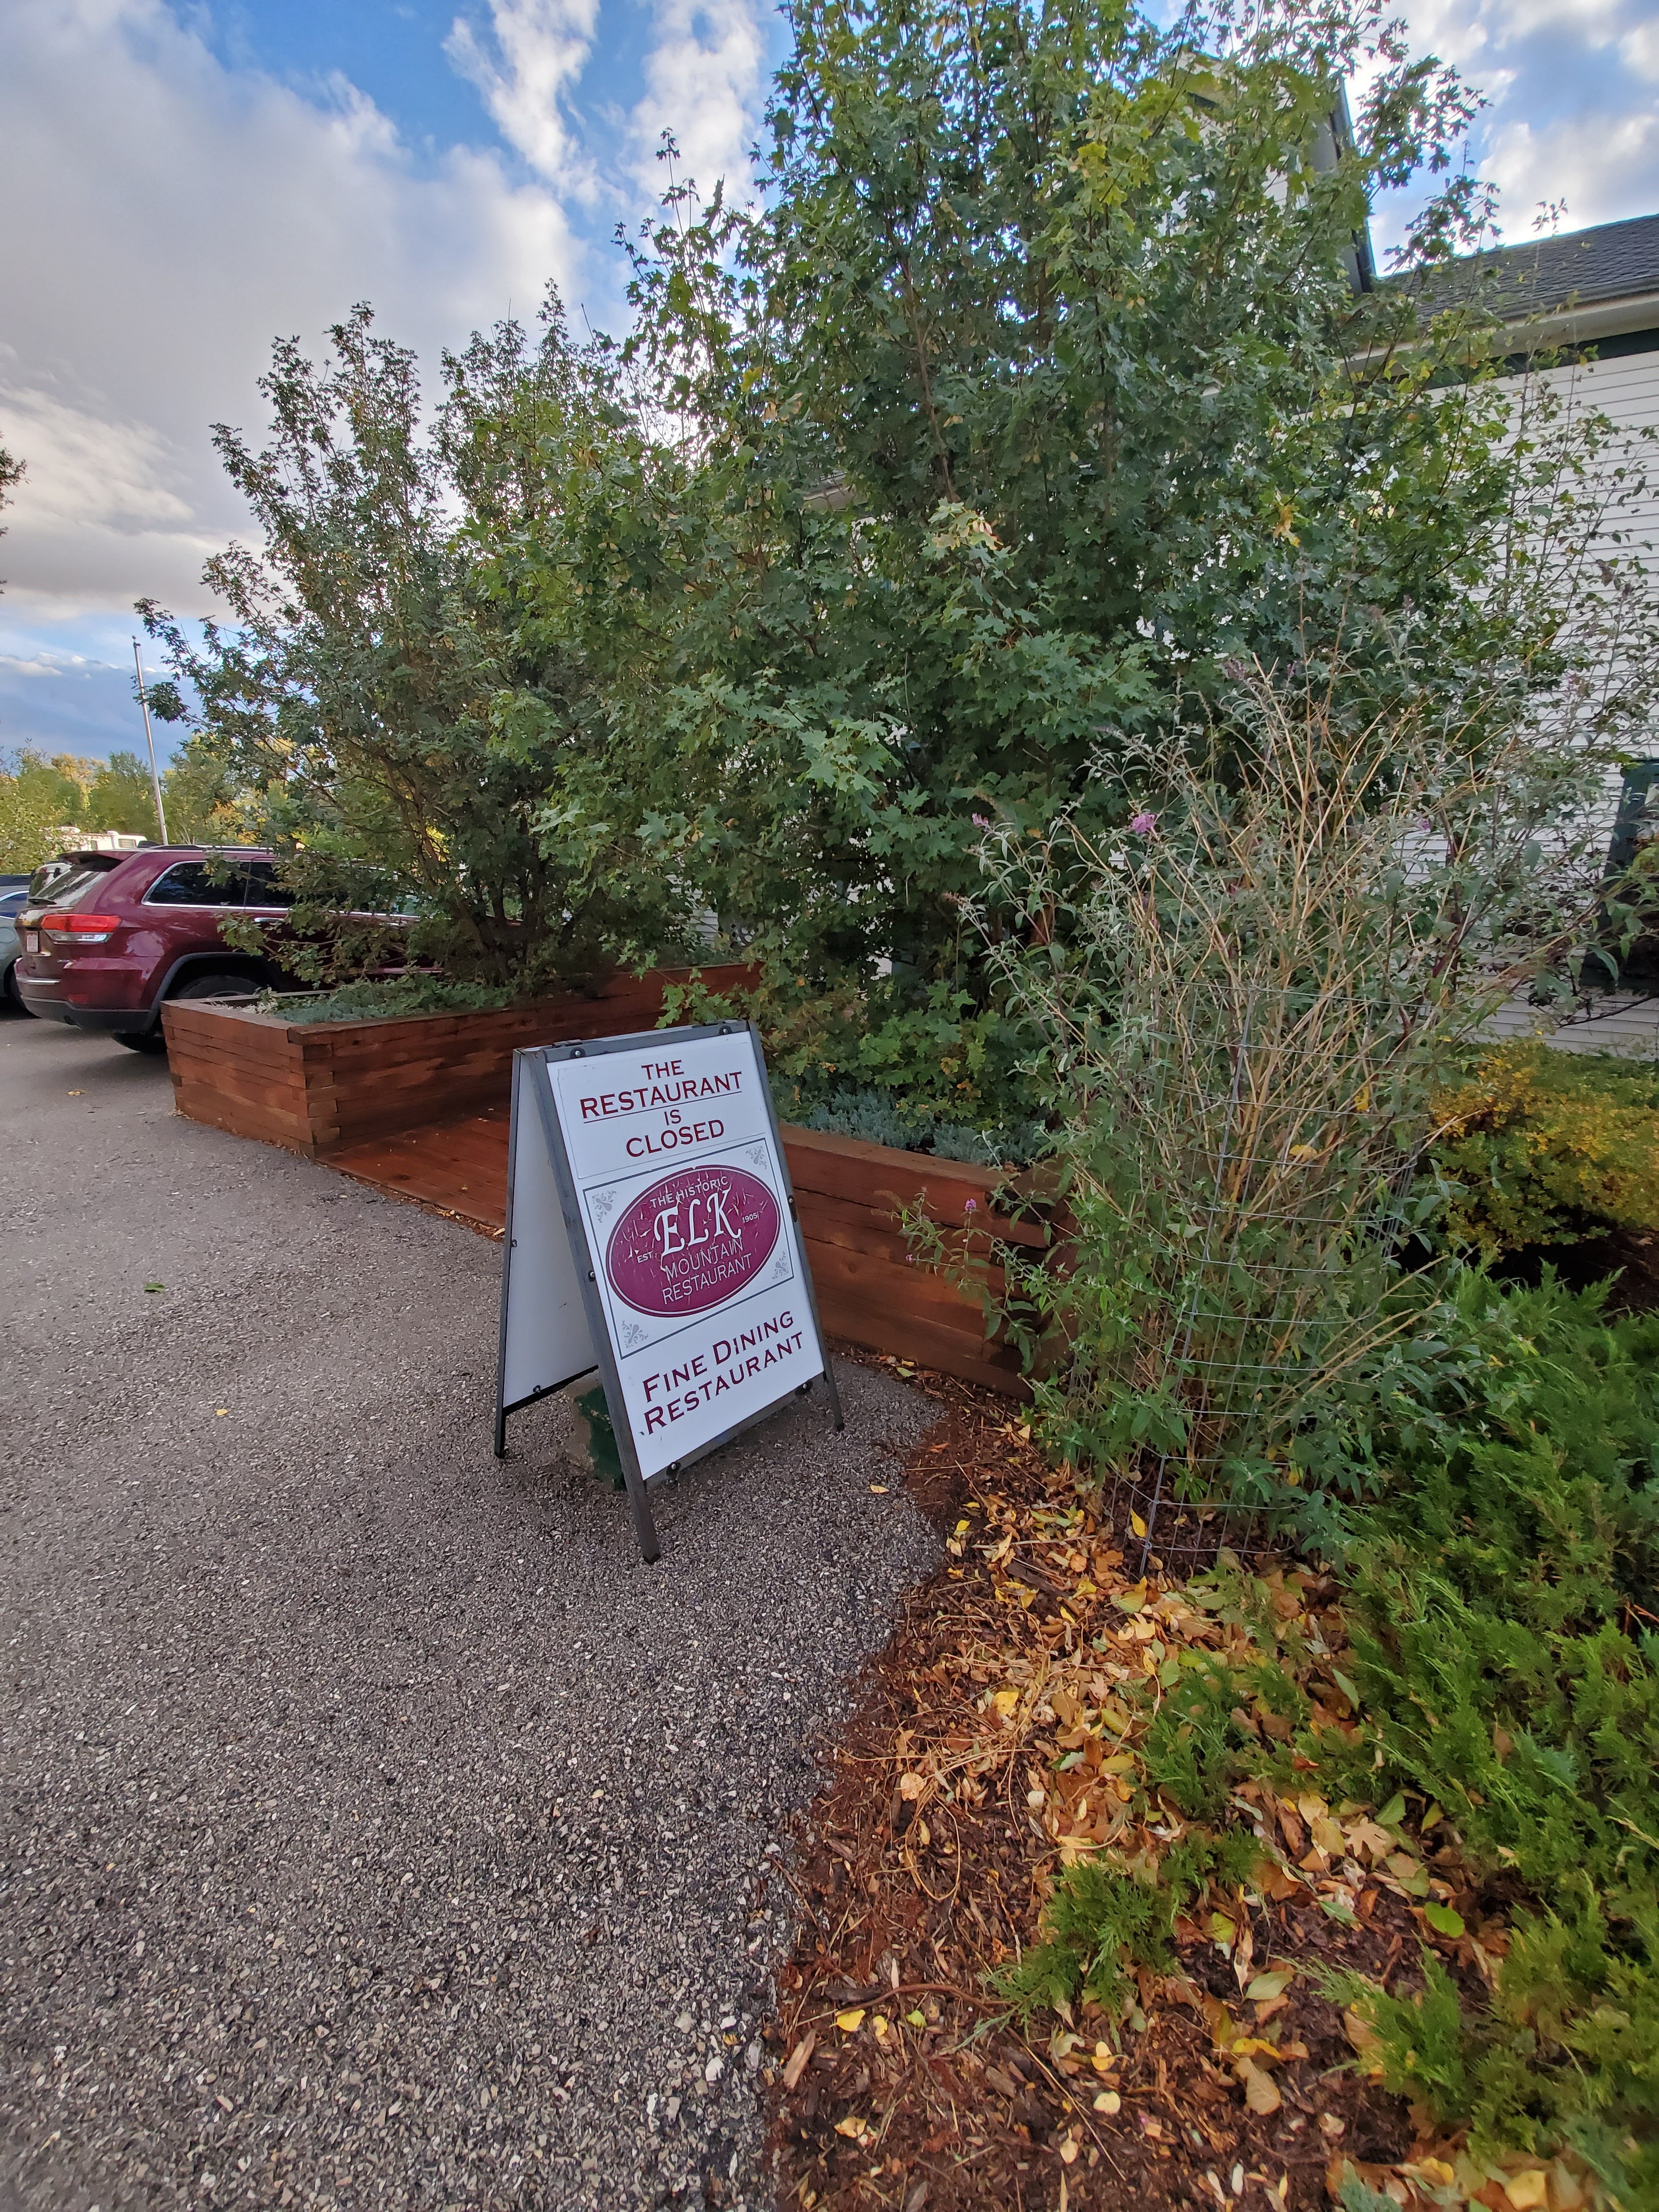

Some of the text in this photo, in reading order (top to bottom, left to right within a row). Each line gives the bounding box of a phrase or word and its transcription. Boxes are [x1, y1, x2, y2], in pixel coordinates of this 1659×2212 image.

[641, 1059, 685, 1080] THE
[579, 1071, 742, 1119] RESTAURANT
[663, 1109, 682, 1126] IS
[626, 1119, 725, 1157] CLOSED
[649, 1176, 728, 1209] THE HISTORIC
[654, 1188, 742, 1257] ELK
[742, 1212, 758, 1224] 1905
[662, 1253, 752, 1305] RESTAURANT
[664, 1236, 744, 1283] MOUNTAIN
[642, 1310, 794, 1403] FINE DINING
[643, 1331, 803, 1435] RESTAURANT
